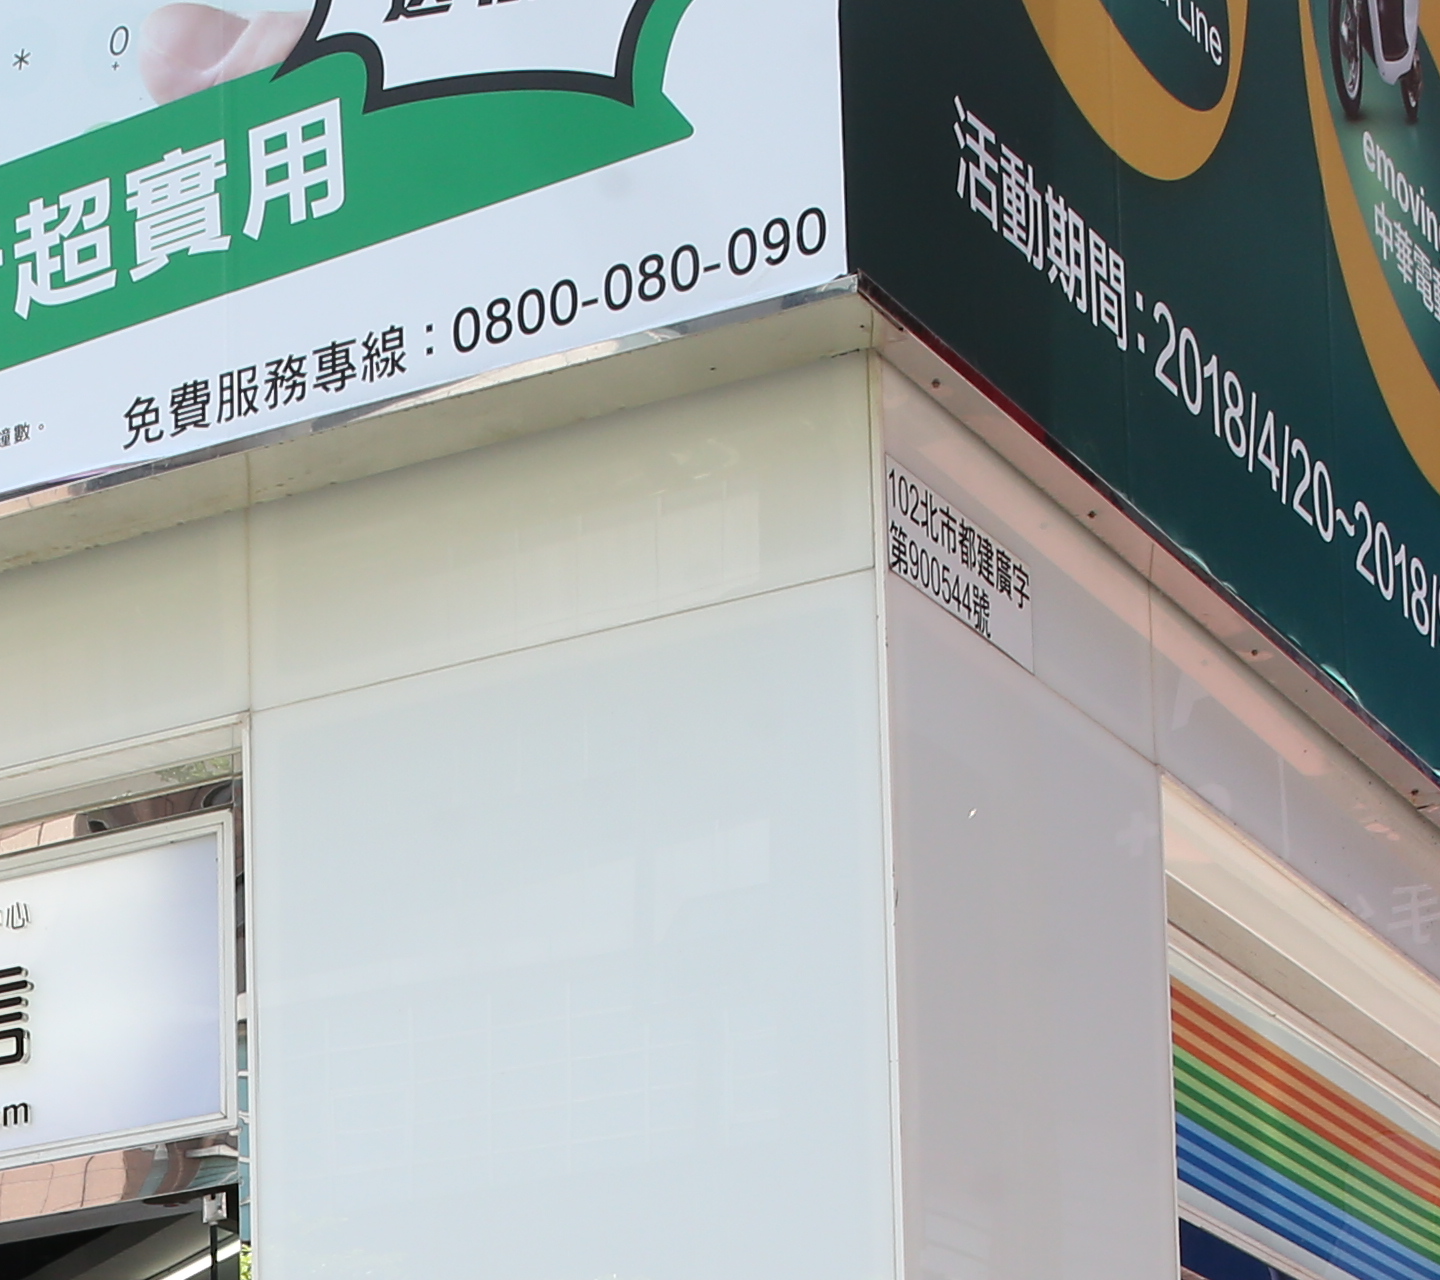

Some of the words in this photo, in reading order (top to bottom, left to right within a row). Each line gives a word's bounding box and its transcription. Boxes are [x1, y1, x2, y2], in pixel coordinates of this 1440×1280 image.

[888, 468, 1031, 609] 102北市都建廣字
[890, 520, 992, 639] 第900544號
